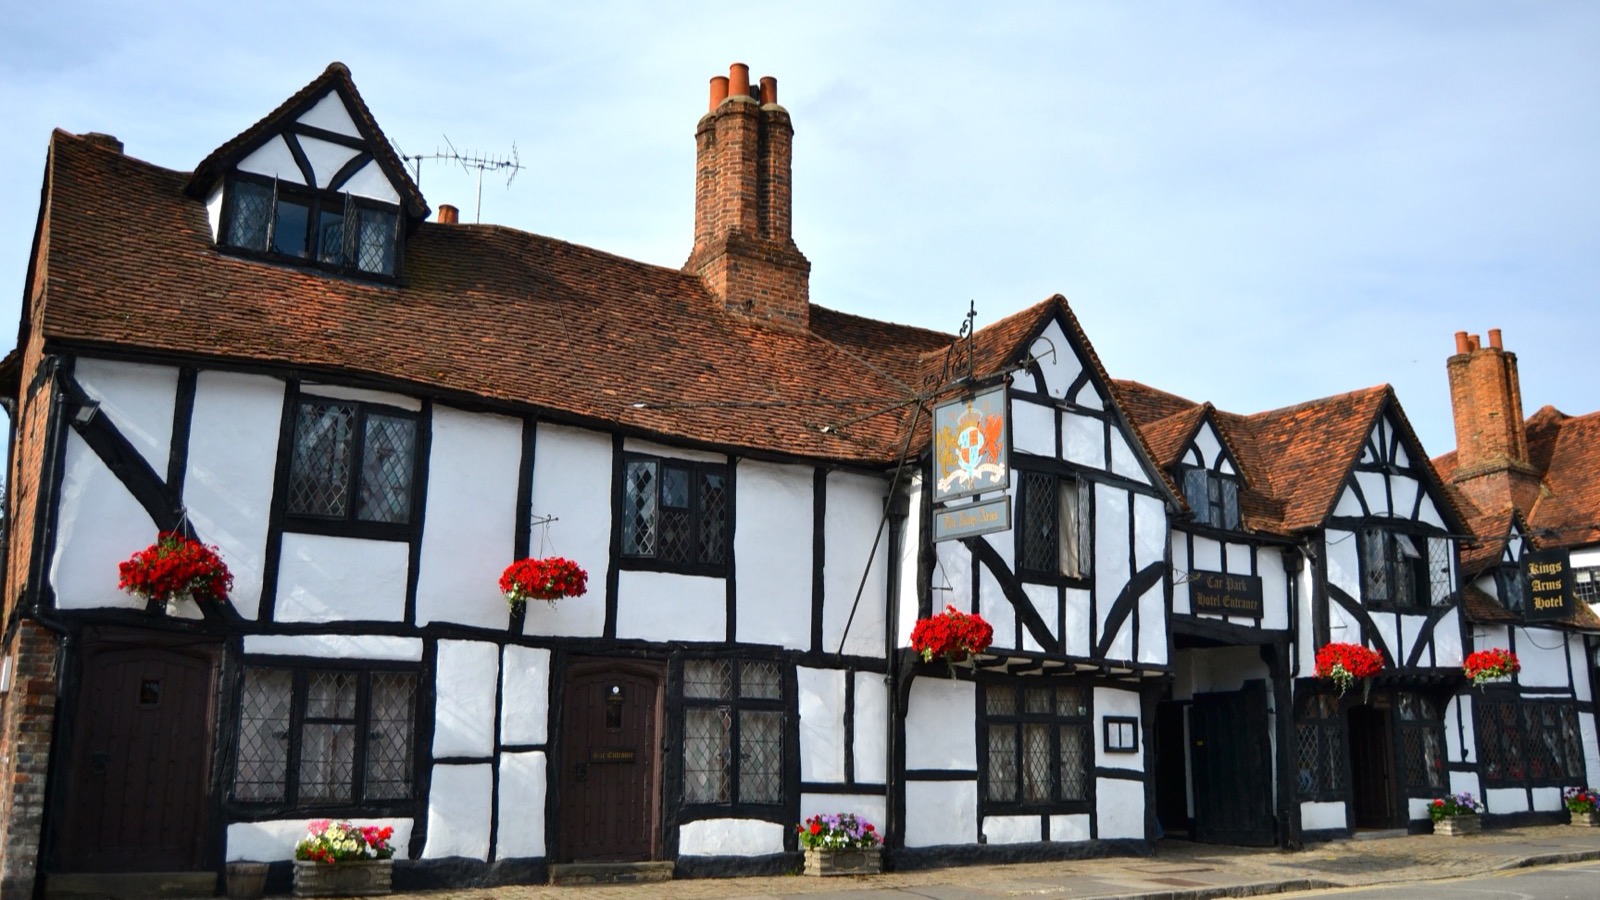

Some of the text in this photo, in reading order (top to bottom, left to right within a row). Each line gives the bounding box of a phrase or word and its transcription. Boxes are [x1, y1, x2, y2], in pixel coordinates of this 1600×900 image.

[979, 508, 998, 522] Arms
[1528, 562, 1562, 575] Kings
[1207, 576, 1247, 592] Car Park
[1531, 579, 1562, 592] Arms
[1196, 592, 1258, 609] Hotel Entrance
[1533, 595, 1563, 610] Hotel
